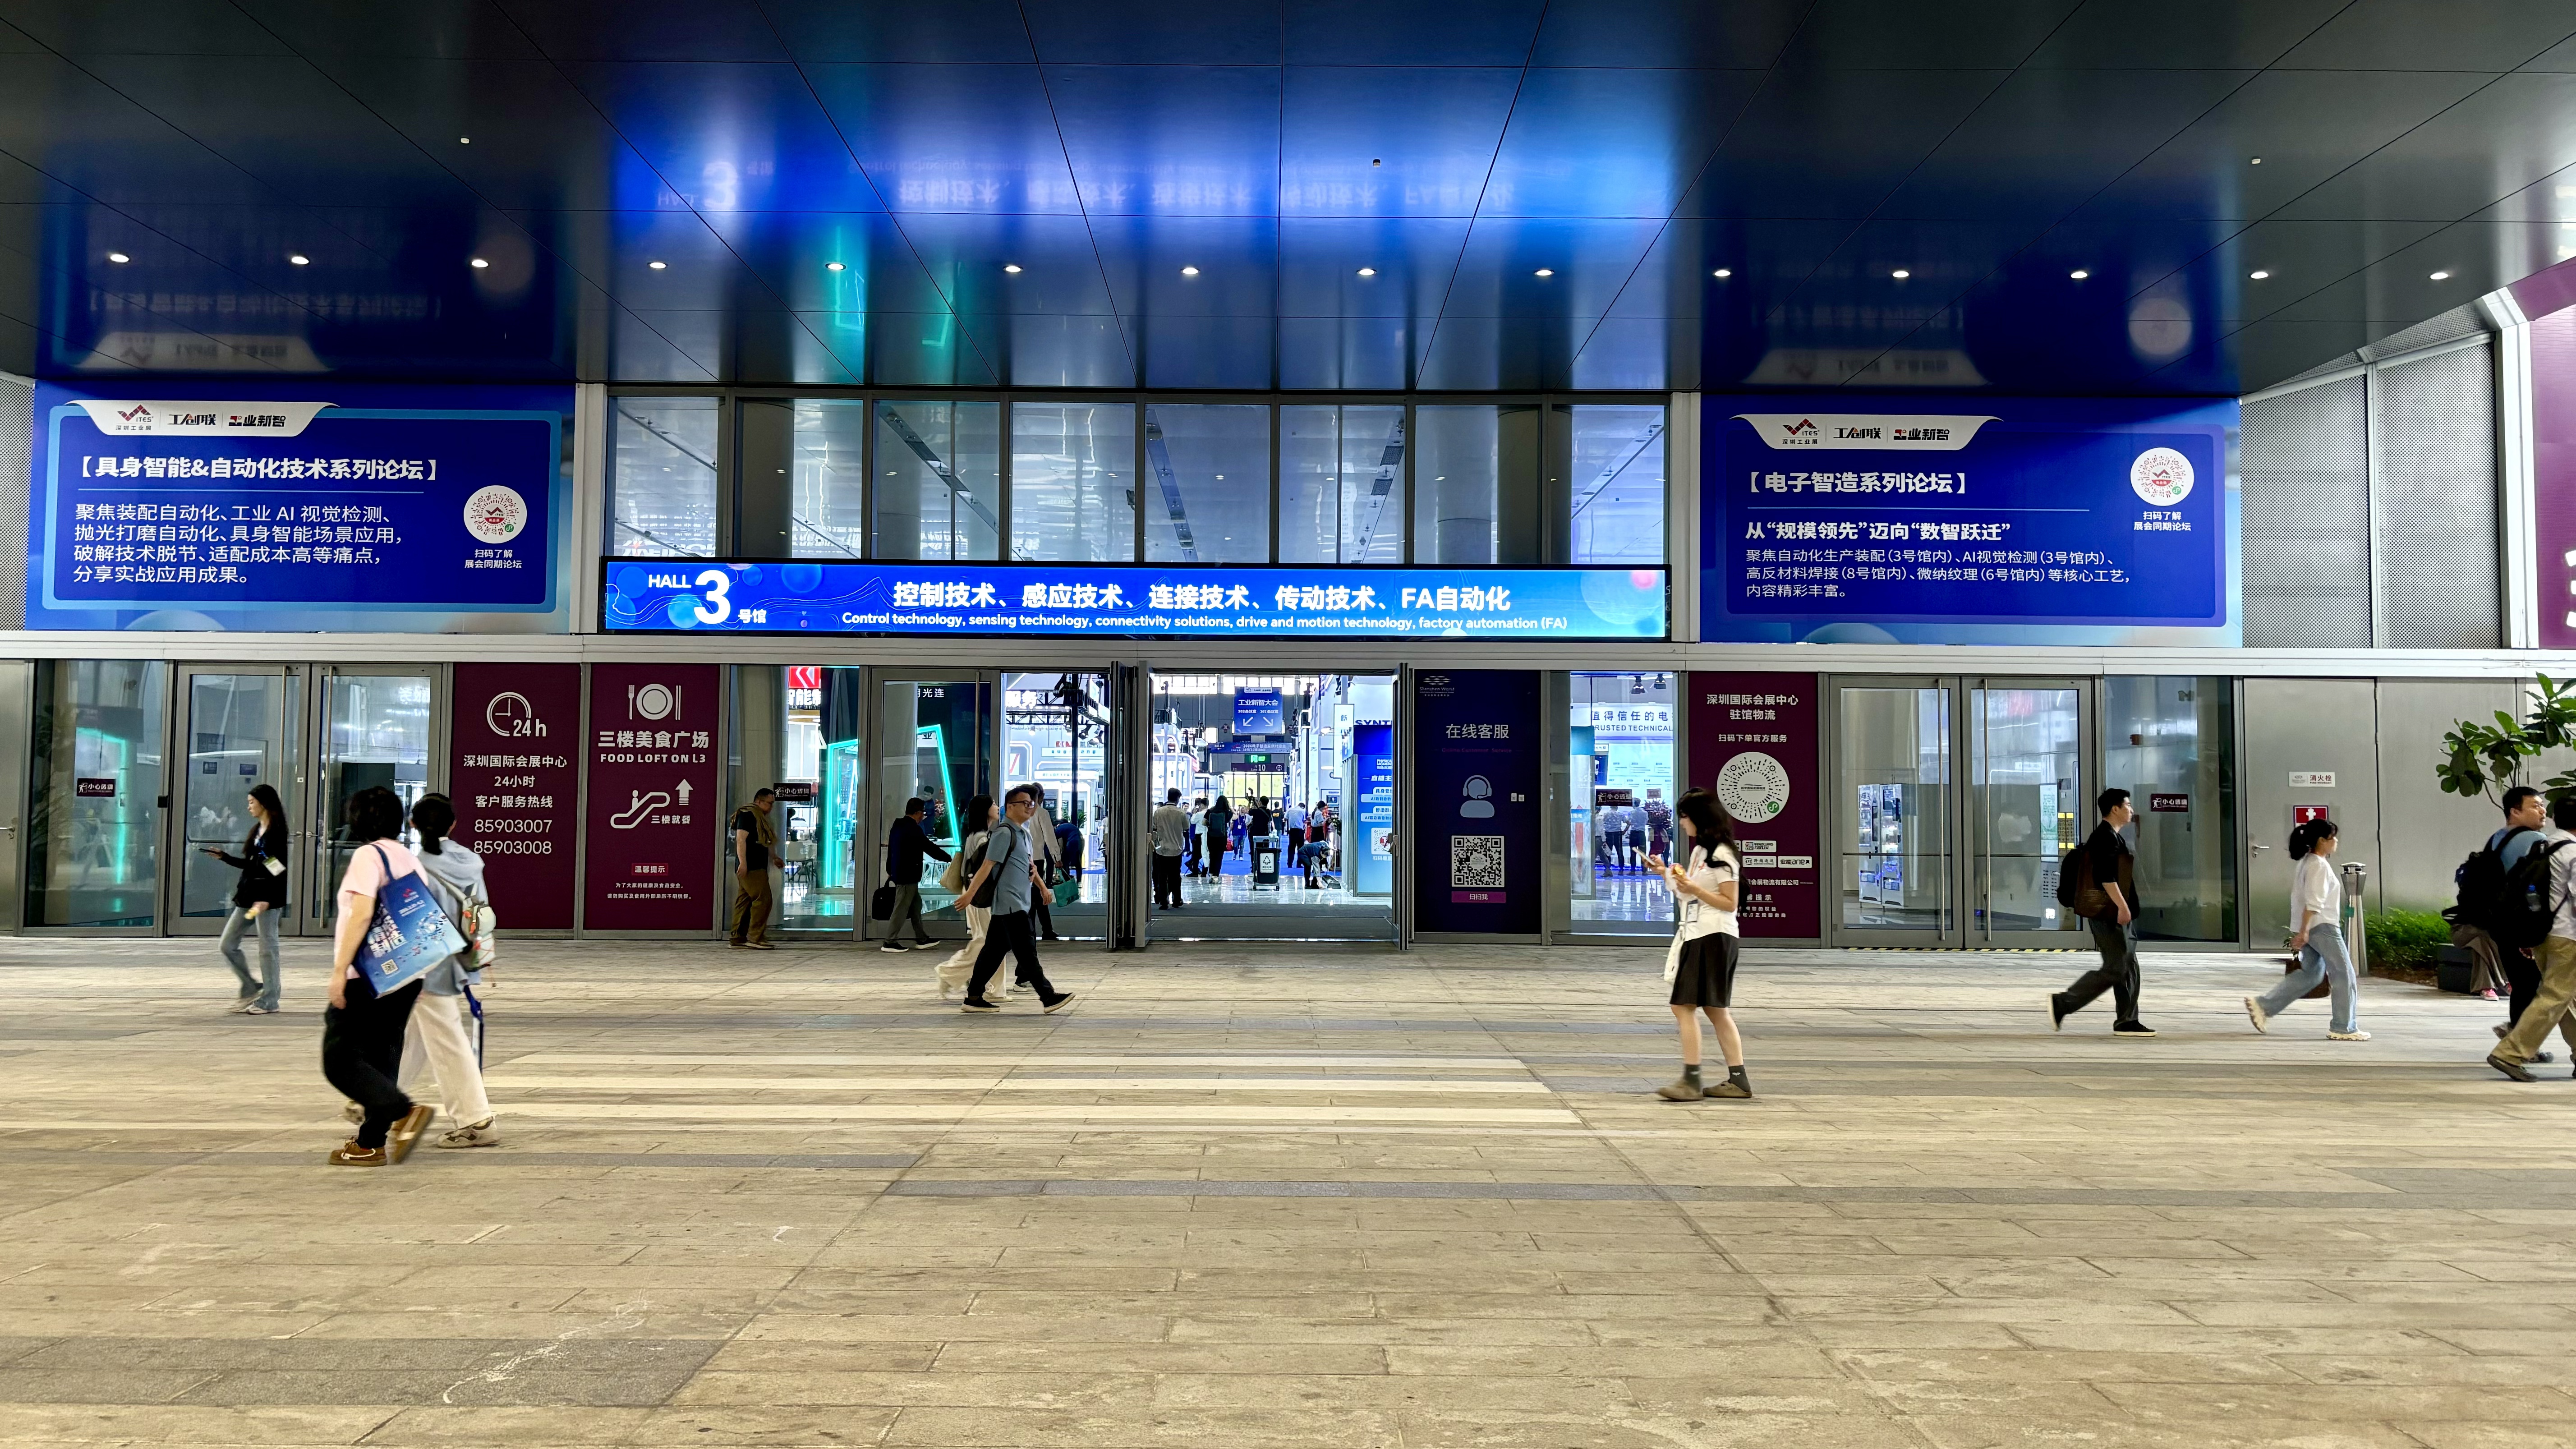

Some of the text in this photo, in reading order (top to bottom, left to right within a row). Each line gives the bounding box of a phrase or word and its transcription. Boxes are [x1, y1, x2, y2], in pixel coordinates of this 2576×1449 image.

[83, 456, 436, 480] 【具身智能&自动化技术系列论坛】
[1751, 471, 1965, 494] 【电子智造系列论坛】
[75, 503, 389, 523] 聚焦装配自动化、工业 AI 视觉检测、
[2143, 511, 2182, 520] 扫码了解
[1745, 522, 2010, 541] 从“规模领先”迈向“数智跃迁”
[2134, 521, 2191, 531] 展会同期论坛
[74, 524, 401, 545] 抛光打磨自动化、具身智能场景应用，
[74, 544, 380, 566] 破解技术脱节、适配成本高等痛点，
[474, 549, 513, 558] 扫码了解
[464, 559, 522, 569] 展会同期论坛
[73, 565, 247, 583] 分享实战应用成果。
[648, 569, 730, 625] HALL 3
[893, 581, 1511, 611] 控制技术、感应技术、连接技术、传动技术、FA自动化
[1747, 584, 1845, 597] 内容精彩丰富。
[736, 608, 767, 624] 号馆
[842, 611, 1568, 631] Control technology, sensing technology, connectivity solutions, drive and motion technology, factory automation (FA)
[917, 688, 945, 698] 光连
[1707, 694, 1799, 705] 深圳国际会展中心
[1592, 711, 1673, 721] 值得信任的电
[1730, 709, 1776, 720] 驻馆物流
[512, 718, 547, 738] 24h
[1446, 723, 1509, 739] 在线客服
[598, 730, 709, 748] 三楼美食广场
[1718, 734, 1787, 742] 扫码下单官方服务
[464, 754, 567, 768] 深圳国际会展中心
[600, 754, 706, 763] FOOD LOFT ON L3
[494, 775, 535, 787] 24小时
[475, 795, 553, 808] 客户服务热线
[474, 819, 552, 833] 85903007
[651, 814, 690, 824] 三楼就餐
[474, 840, 553, 855] 85903008
